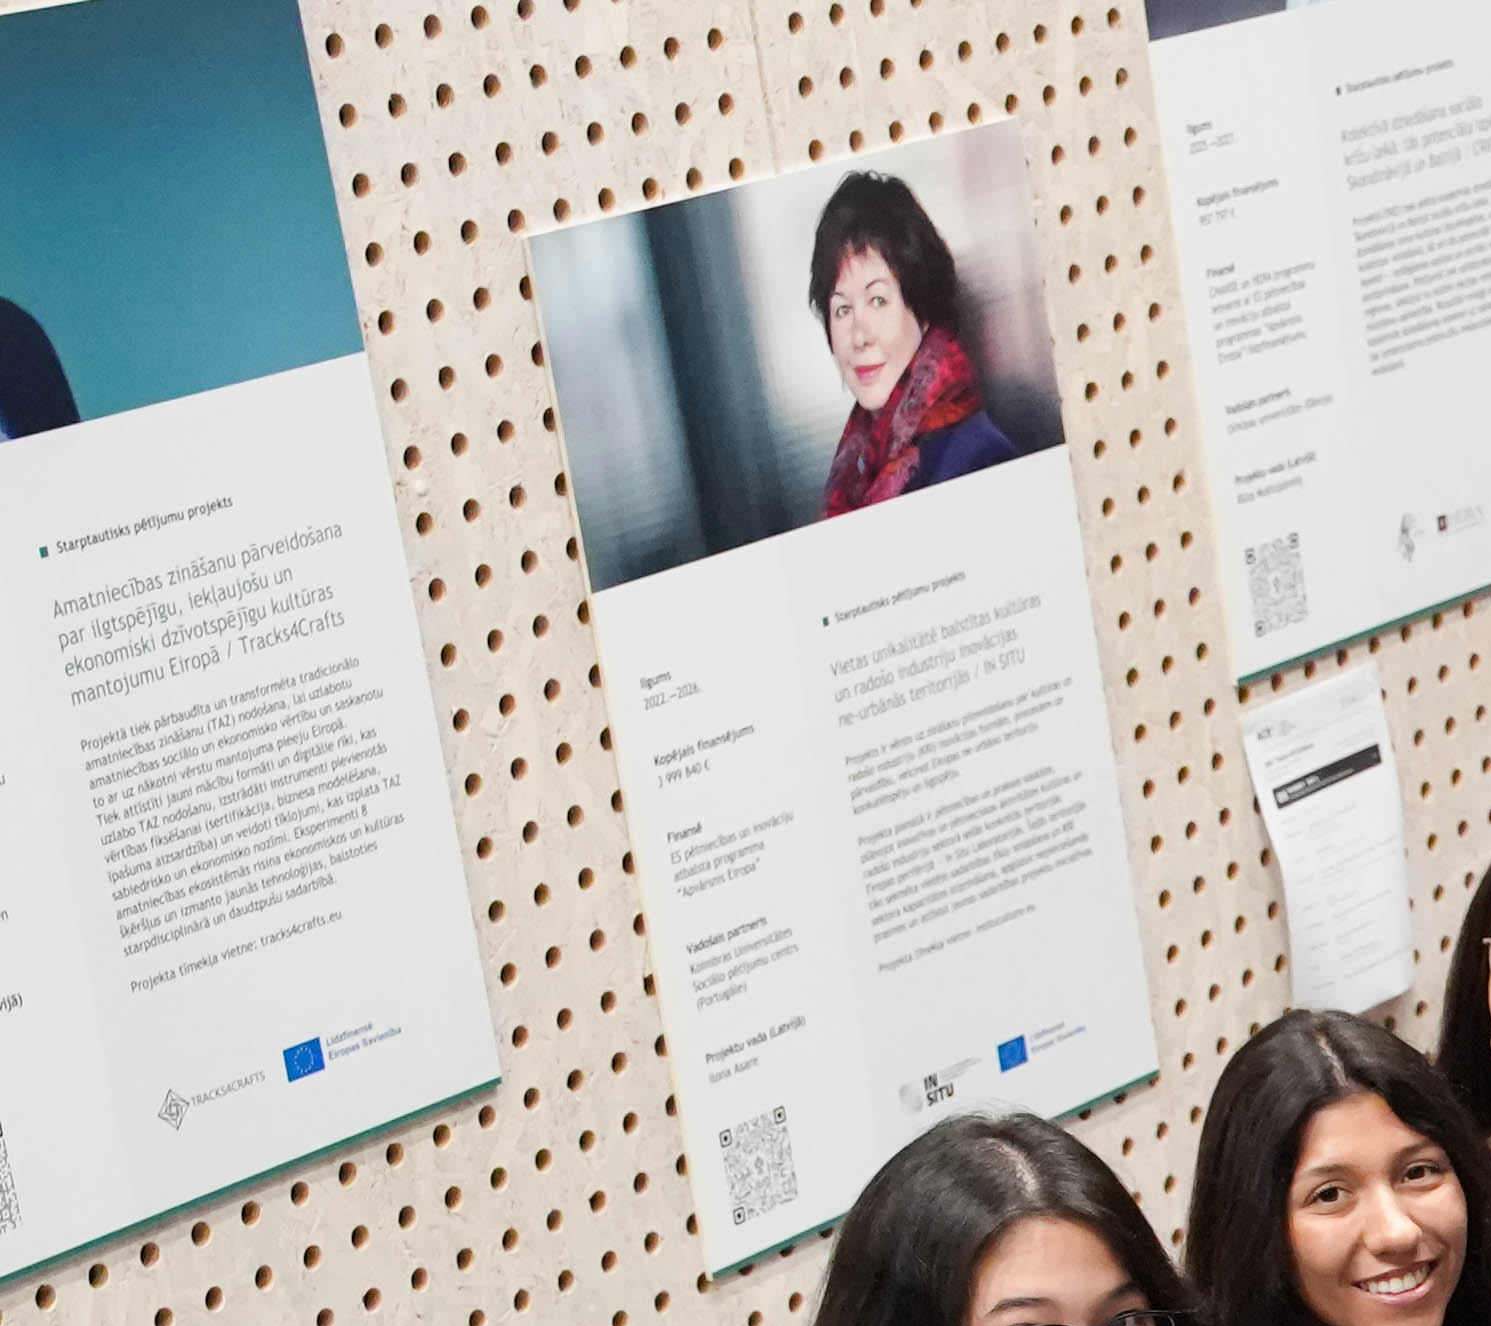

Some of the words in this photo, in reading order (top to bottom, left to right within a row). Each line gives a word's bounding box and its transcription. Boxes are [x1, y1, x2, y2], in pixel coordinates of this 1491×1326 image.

[55, 524, 131, 554] Starptautisks
[132, 510, 185, 536] pētījumu
[186, 496, 233, 521] projekts
[53, 574, 163, 619] Amatniecības
[165, 553, 236, 586] zināšanu
[240, 523, 343, 570] pārveidošana
[57, 626, 85, 654] par
[90, 601, 183, 640] ilgtspējīgu,
[187, 571, 269, 610] iekļaujošu
[272, 567, 293, 585] un
[63, 632, 156, 677] ekonomiski
[160, 604, 267, 648] dzīvotspējīgu
[269, 584, 334, 615] kultūras
[70, 665, 165, 707] mantojumu
[167, 644, 220, 677] Eiropā
[236, 609, 345, 654] Tracks4Crafts
[190, 1070, 266, 1107] TRACKS4CRAFTS
[926, 1082, 954, 1107] SITU
